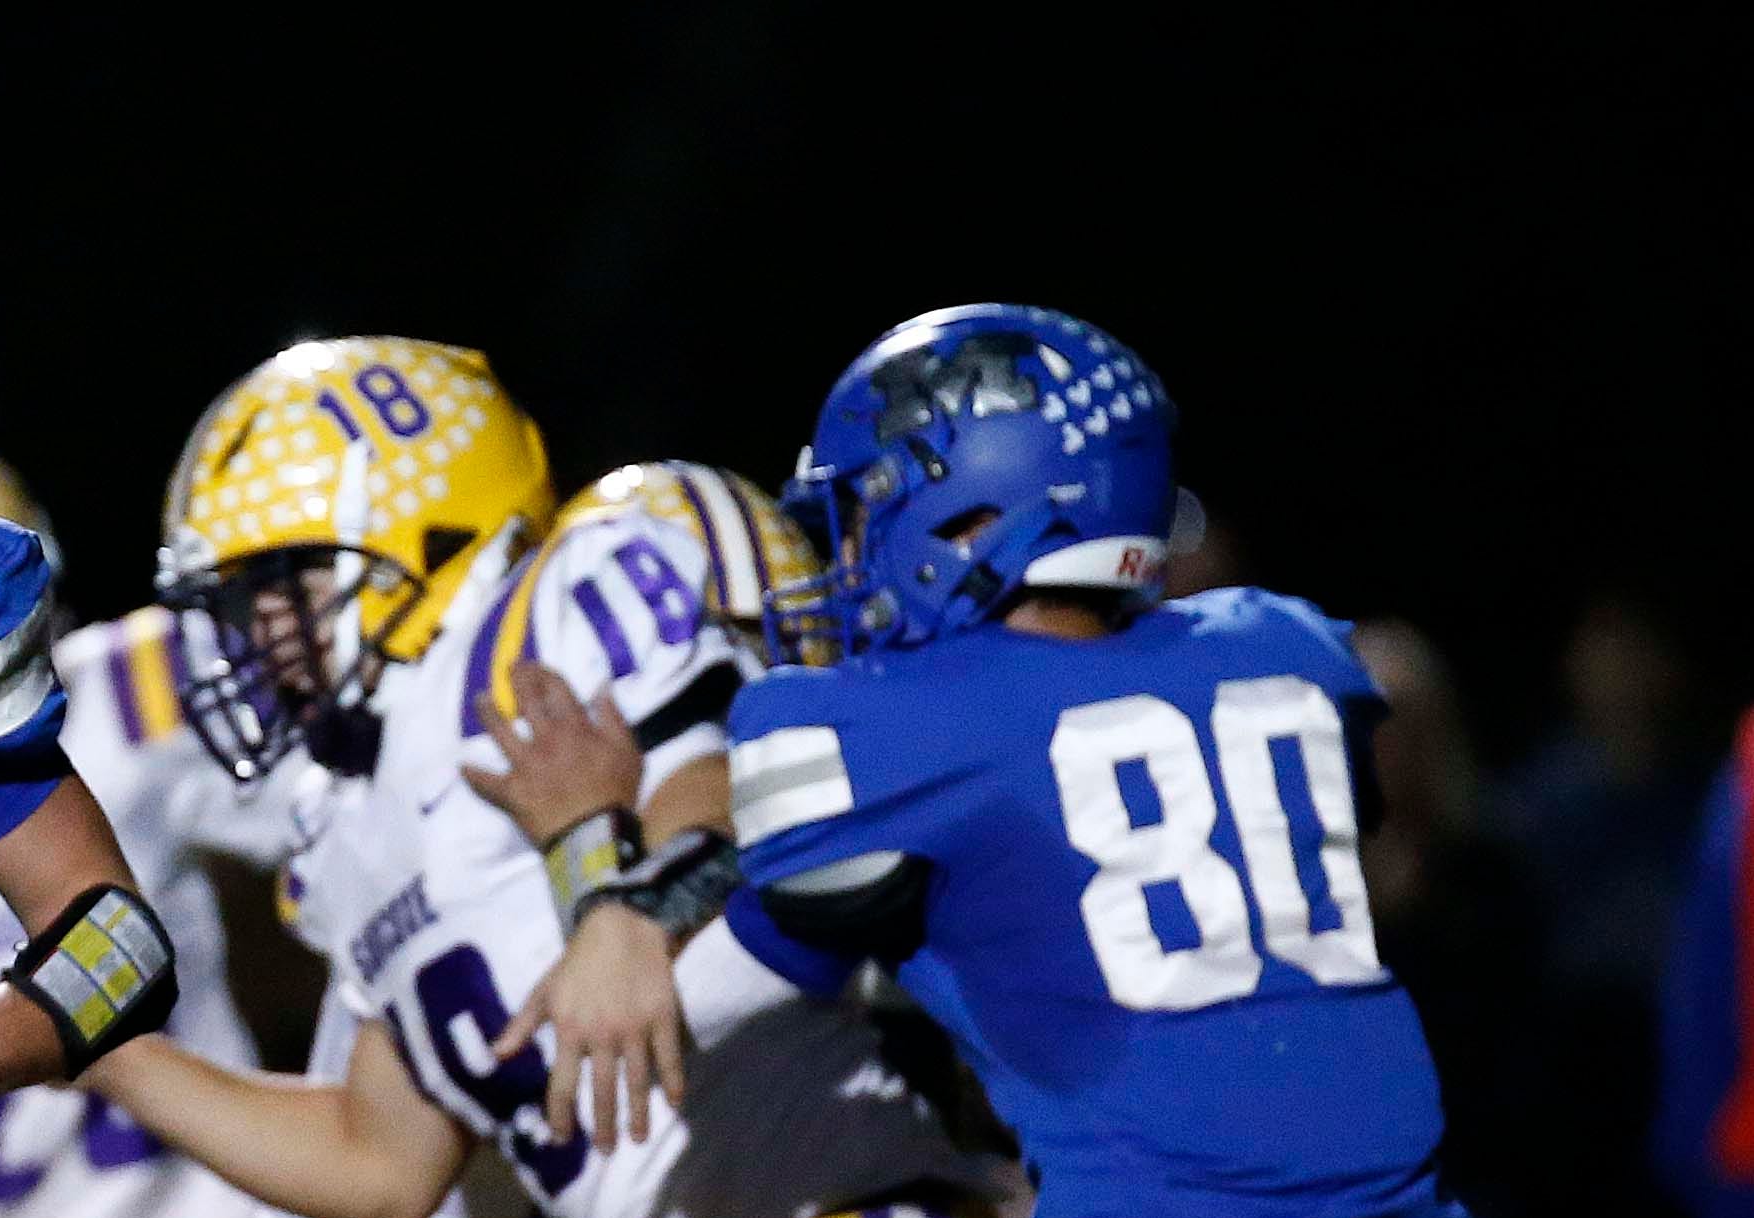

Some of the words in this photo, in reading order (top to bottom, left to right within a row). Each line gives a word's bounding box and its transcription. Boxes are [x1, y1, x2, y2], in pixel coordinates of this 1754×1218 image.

[316, 363, 432, 442] 18
[572, 536, 705, 679] 18
[1049, 675, 1384, 1012] 80
